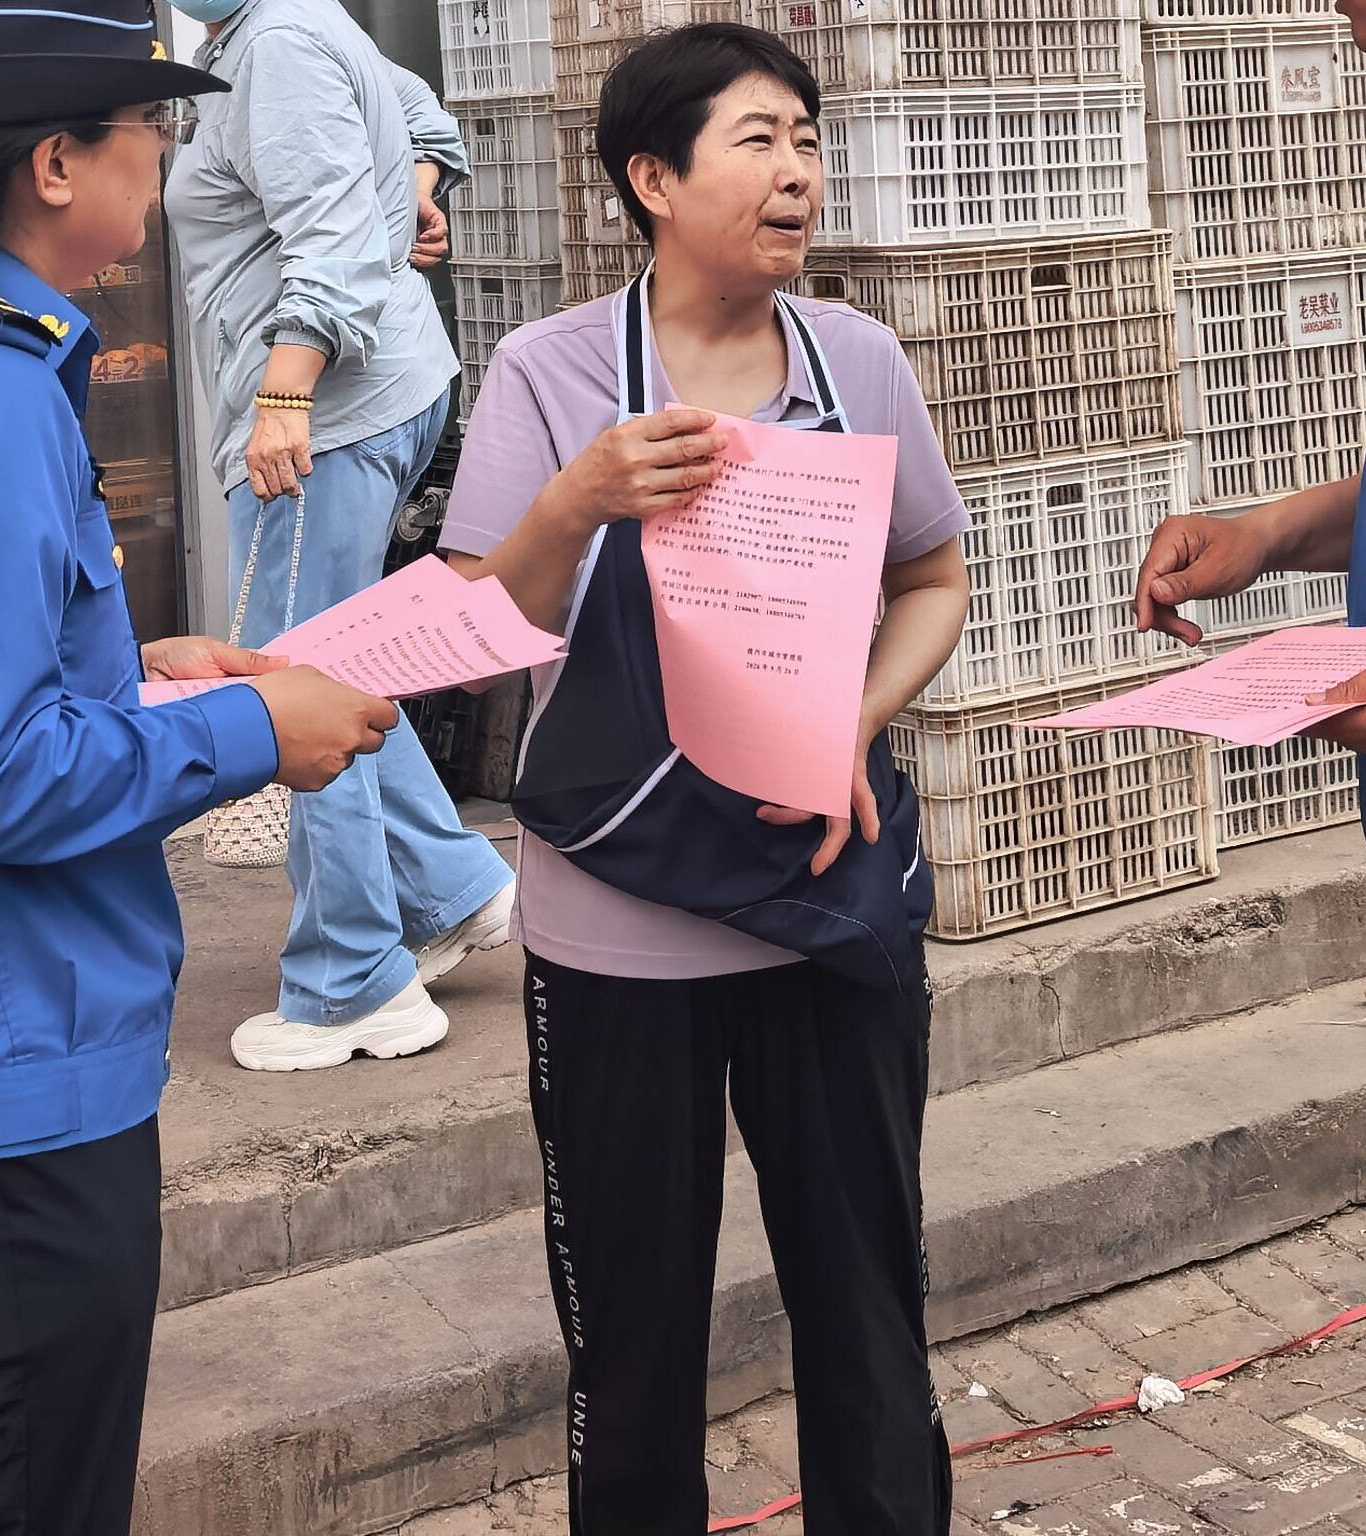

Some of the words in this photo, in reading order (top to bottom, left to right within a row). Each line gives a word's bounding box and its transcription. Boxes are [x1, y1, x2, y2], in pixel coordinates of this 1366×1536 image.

[1299, 292, 1340, 320] 老吴菜业
[532, 975, 549, 1092] ARMOUR
[544, 1139, 565, 1228] UNDER
[555, 1241, 585, 1349] ARMOUR
